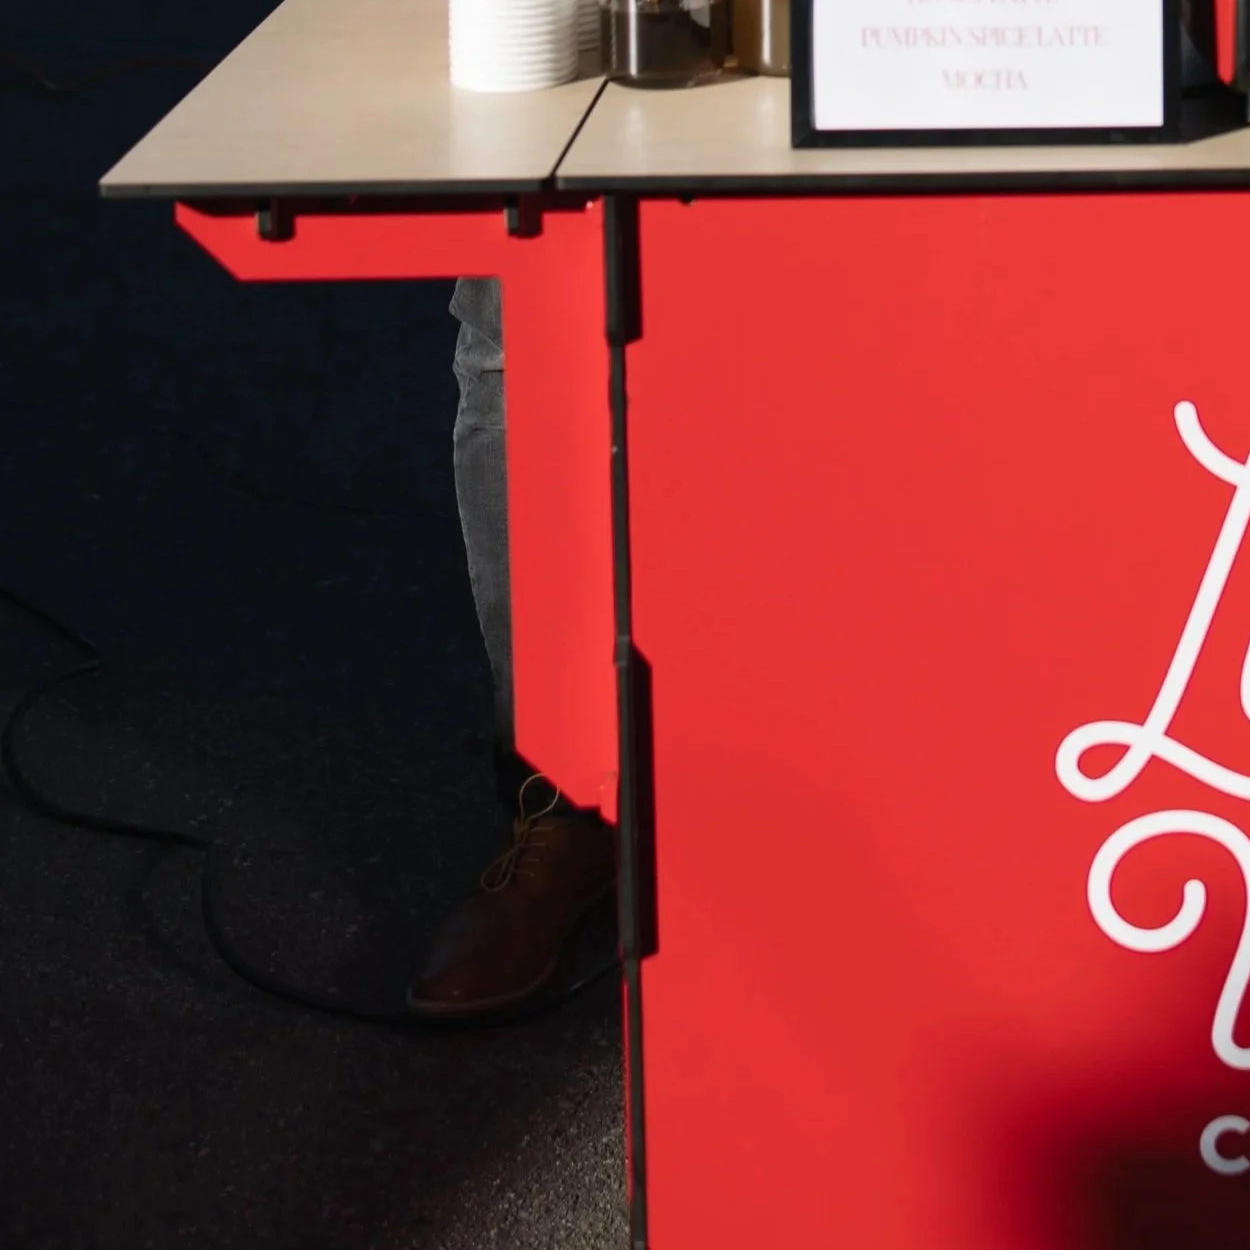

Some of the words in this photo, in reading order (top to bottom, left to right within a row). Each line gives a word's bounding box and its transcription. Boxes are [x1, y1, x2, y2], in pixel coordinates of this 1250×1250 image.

[860, 25, 965, 49] PUMPKIN
[969, 25, 1033, 48] SPICE
[1036, 24, 1109, 48] LATTE
[941, 68, 1030, 91] MOCHA
